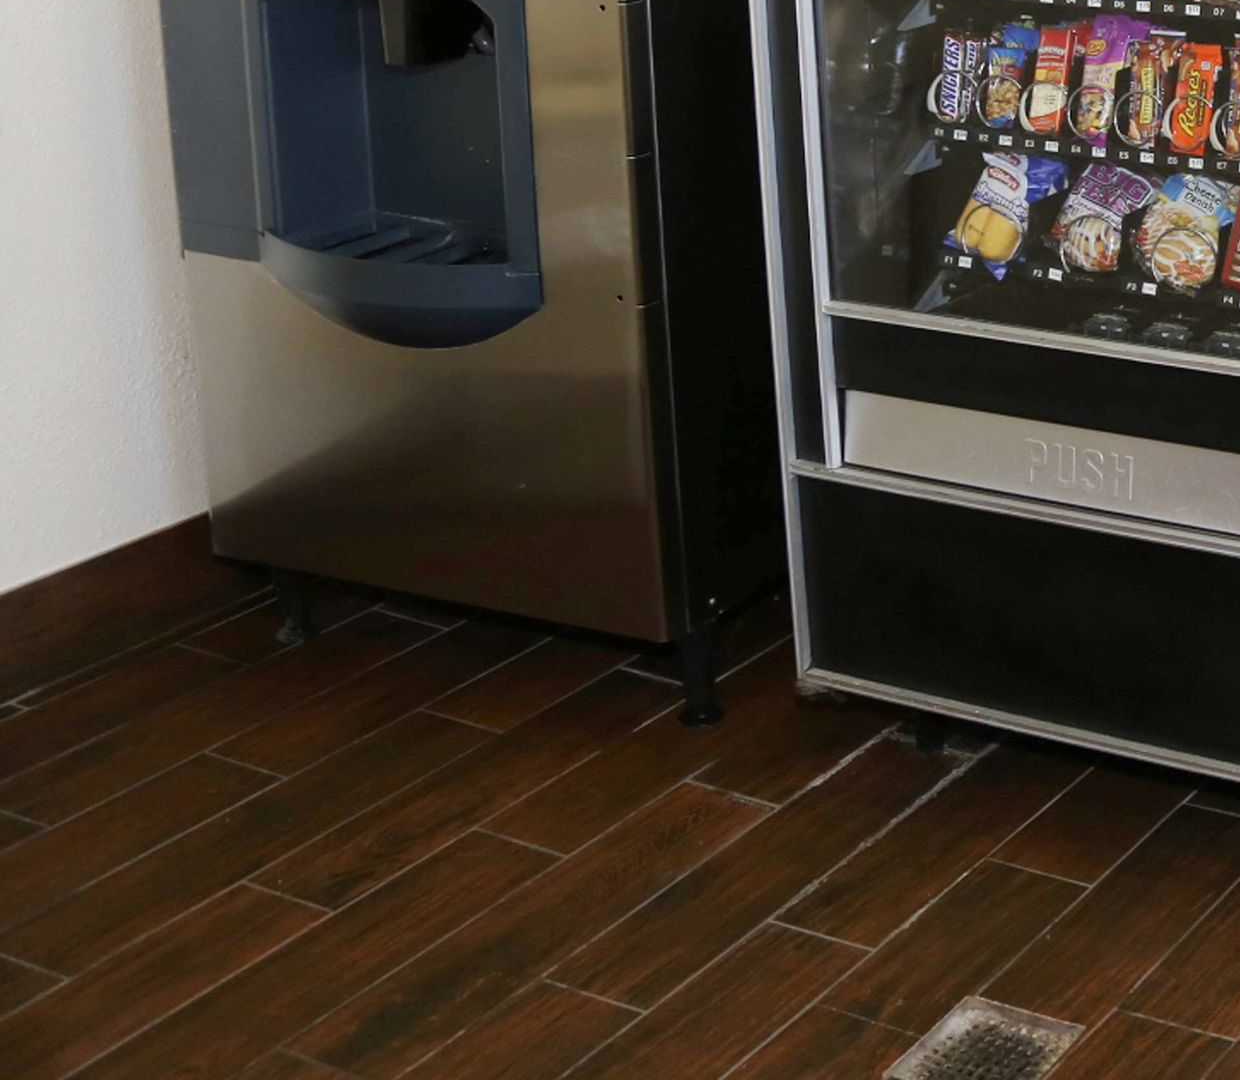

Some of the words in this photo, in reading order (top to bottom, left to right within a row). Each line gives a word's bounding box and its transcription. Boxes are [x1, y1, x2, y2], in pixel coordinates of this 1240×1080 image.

[940, 35, 962, 118] SNICKERS
[1178, 68, 1201, 137] Reese's
[1183, 192, 1215, 214] Danish
[1184, 179, 1222, 207] Cheese
[1024, 437, 1135, 501] PUSH
